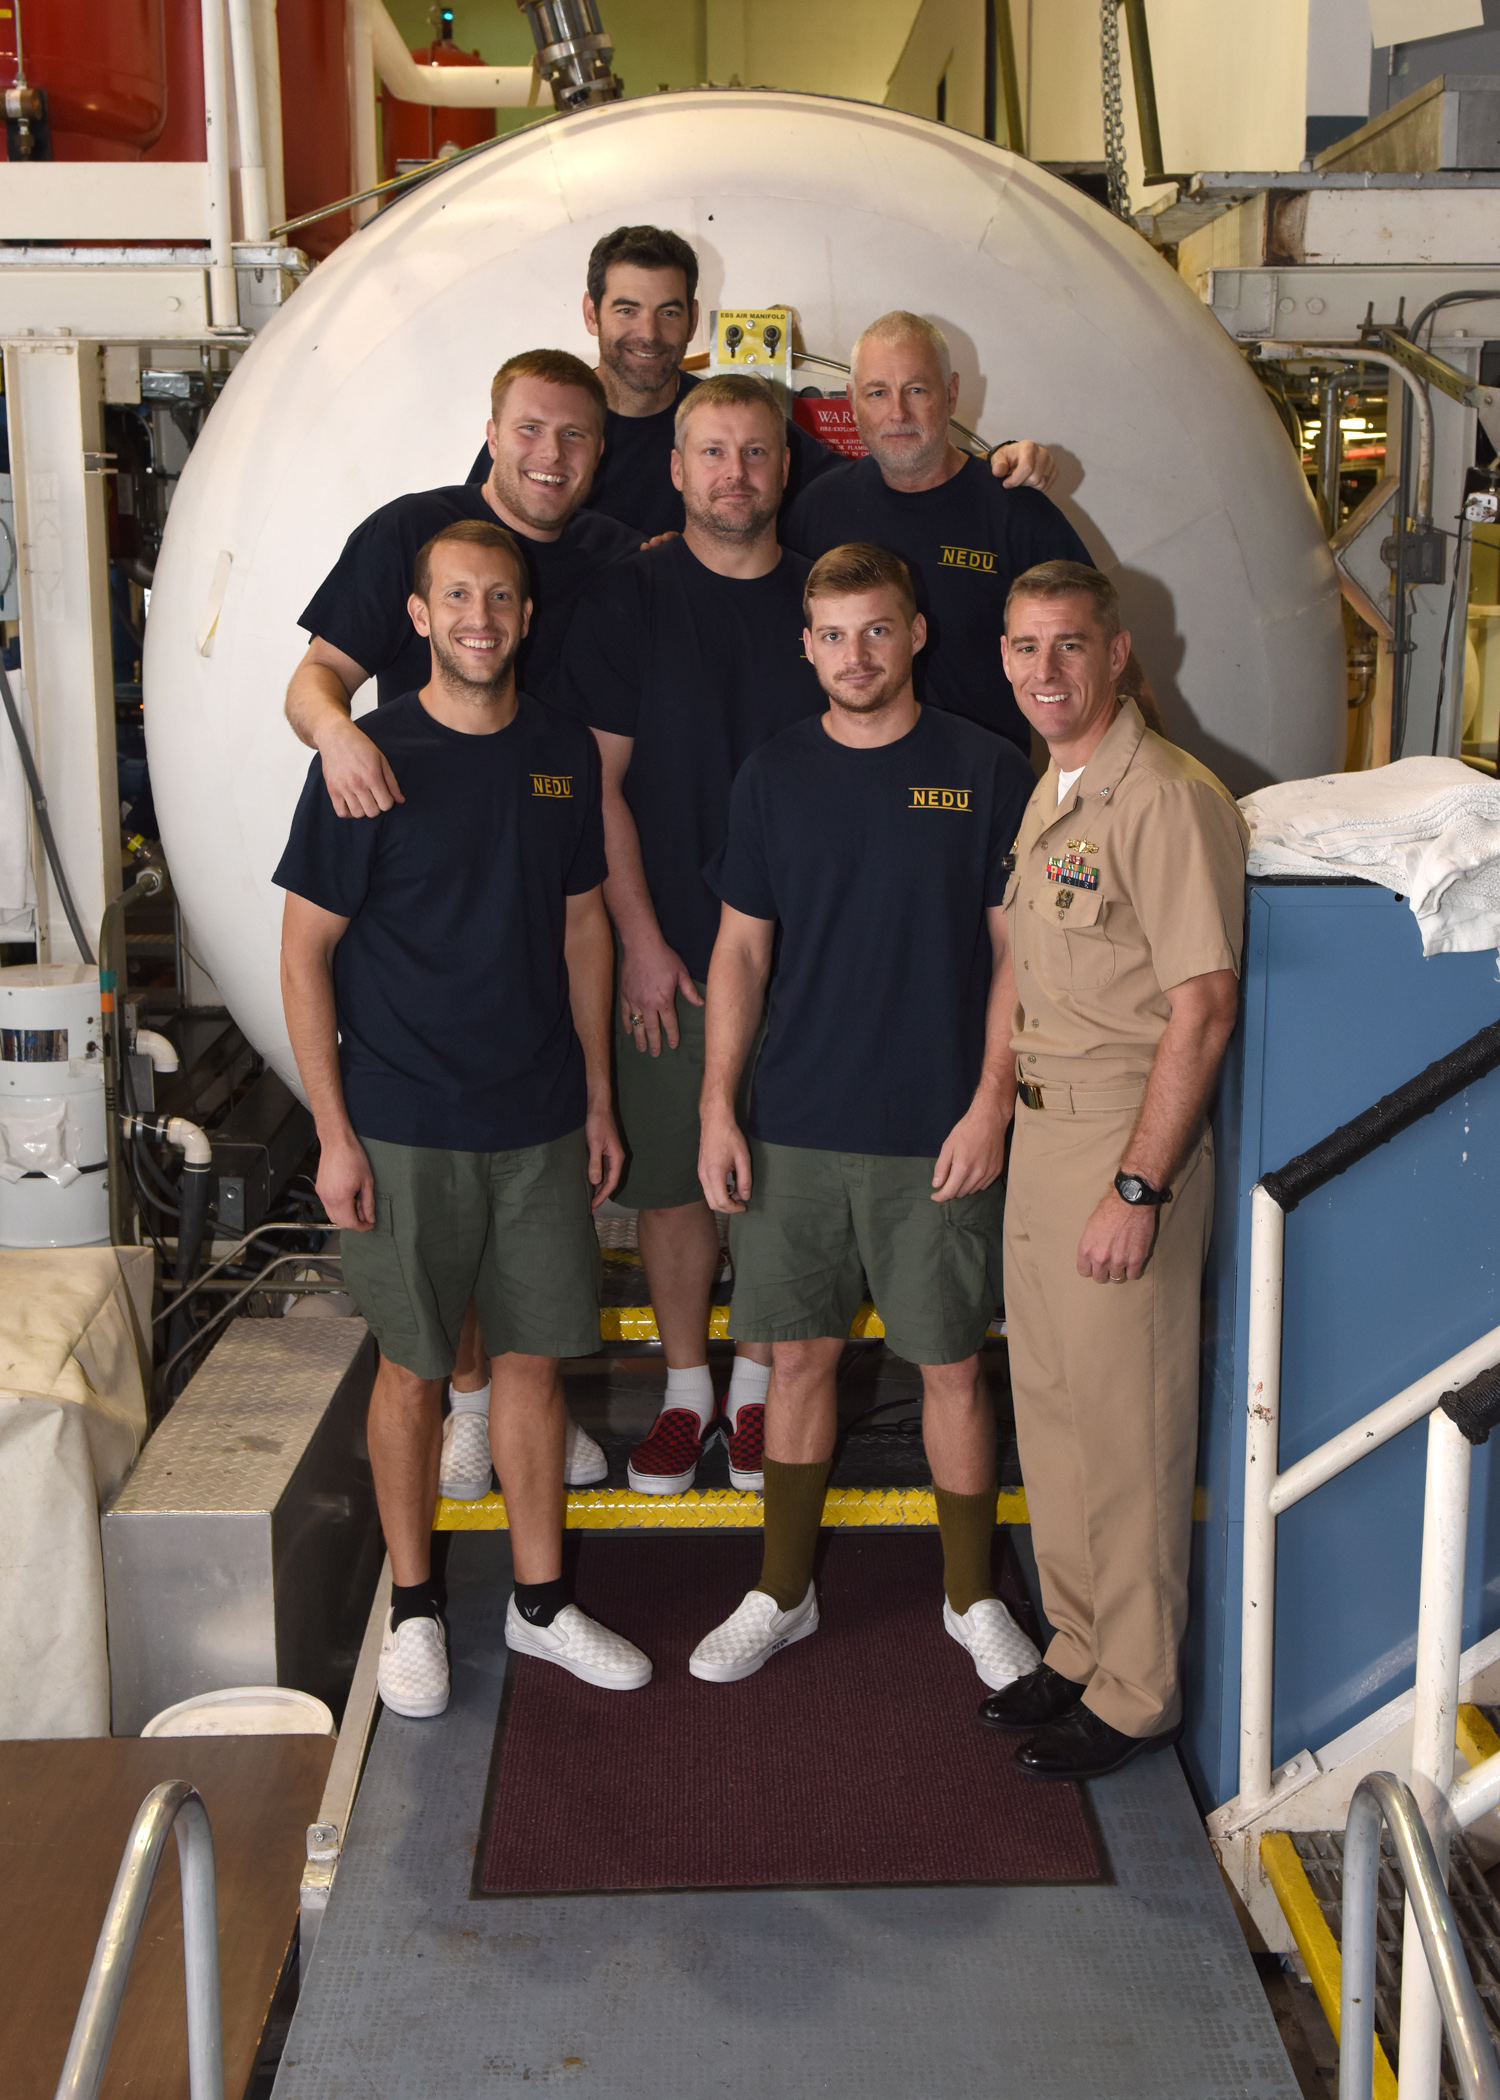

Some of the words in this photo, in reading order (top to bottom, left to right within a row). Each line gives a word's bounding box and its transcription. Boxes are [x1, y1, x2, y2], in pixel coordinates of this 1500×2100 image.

[817, 410, 852, 424] WAR
[943, 548, 994, 570] NEDU
[533, 777, 571, 796] NEDU
[913, 790, 969, 809] NEDU
